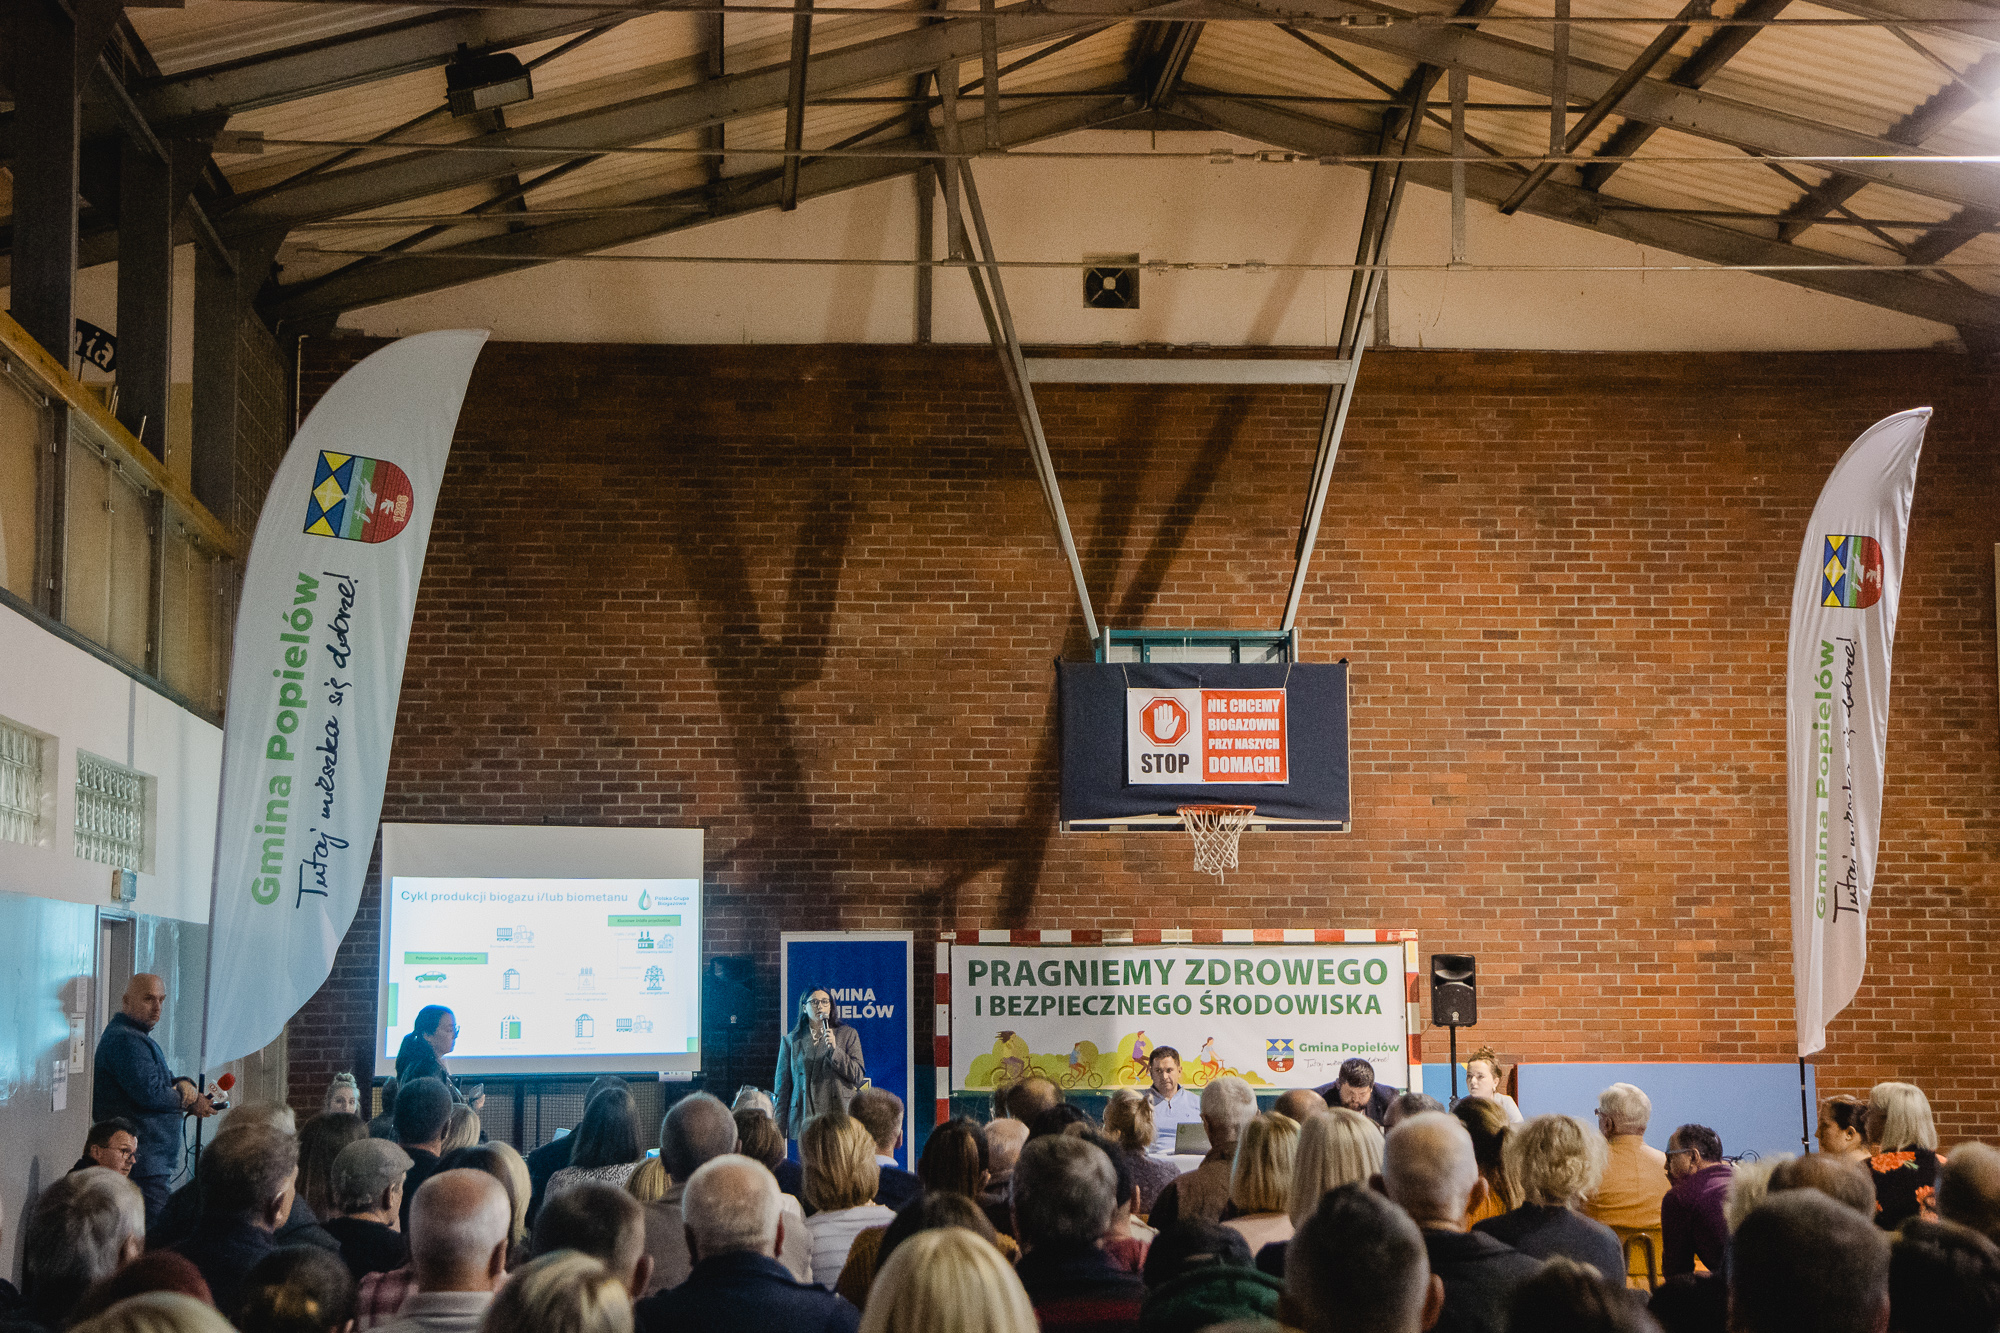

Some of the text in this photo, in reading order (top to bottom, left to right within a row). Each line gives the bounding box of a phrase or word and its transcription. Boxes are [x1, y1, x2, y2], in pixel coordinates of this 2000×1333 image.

[1207, 698, 1280, 713] NIE CHCEMY
[1208, 718, 1280, 731] BIOGAZOWNI
[251, 571, 320, 905] Gmina Popielów
[296, 571, 359, 909] Tutaj mieszka się dobrze!
[1208, 738, 1280, 750] PRZY NASZYCH
[1141, 753, 1190, 774] STOP
[1208, 756, 1280, 773] DOMACH!
[1812, 639, 1835, 919] Gmina Popielów
[401, 890, 628, 904] Cykl produkcji biogazu i/lub biometanu
[968, 958, 1388, 987] PRAGNIEMY ZDROWEGO
[831, 988, 876, 1001] MINA
[836, 1001, 894, 1019] IELÓW
[975, 990, 1382, 1017] I BEZPIECZNEGO ŚRODOWISKA
[1299, 1041, 1400, 1055] Gmina Popielów
